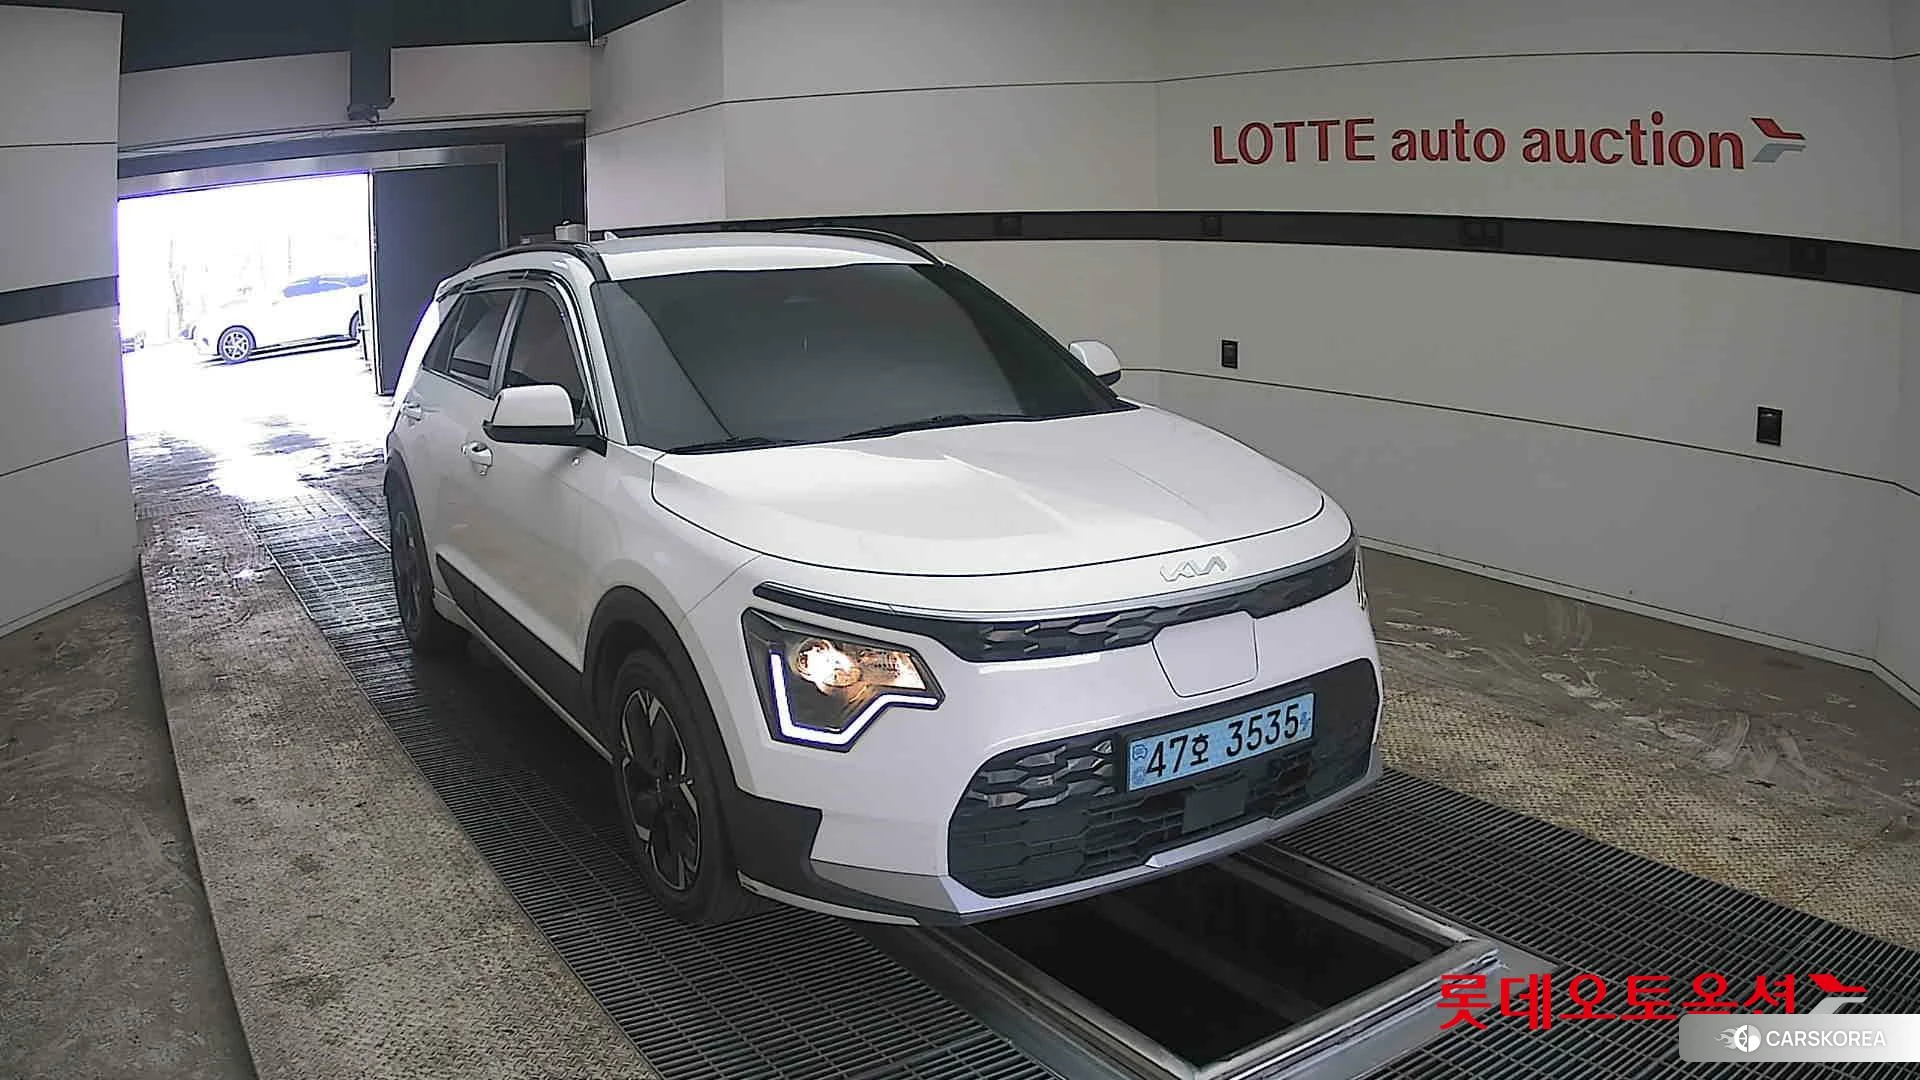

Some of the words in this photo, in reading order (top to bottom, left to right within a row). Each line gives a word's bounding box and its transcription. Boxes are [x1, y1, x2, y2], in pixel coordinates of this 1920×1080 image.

[1212, 117, 1376, 167] LOTTE
[1391, 118, 1506, 163] auto
[1522, 111, 1745, 170] auction
[1146, 732, 1209, 778] 47호
[1226, 703, 1300, 758] 3535
